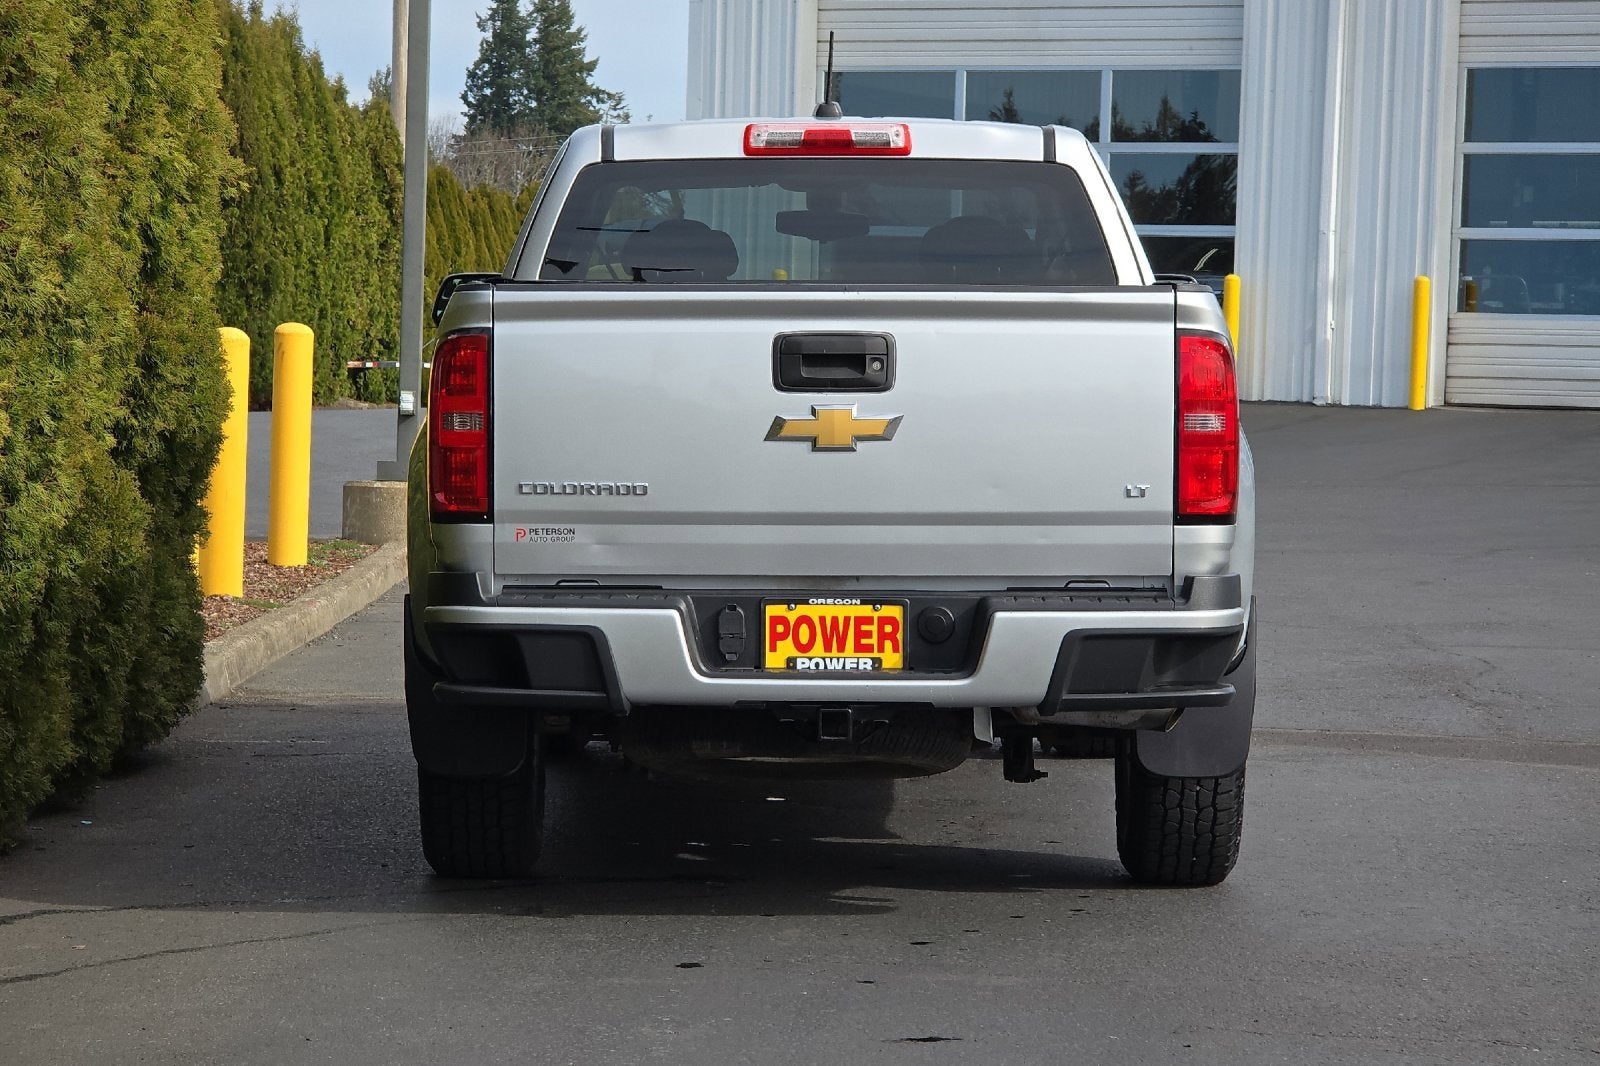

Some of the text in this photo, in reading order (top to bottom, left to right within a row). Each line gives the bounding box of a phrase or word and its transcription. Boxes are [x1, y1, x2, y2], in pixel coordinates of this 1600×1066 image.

[518, 481, 649, 496] COLORADO
[1125, 484, 1151, 498] LT
[529, 527, 576, 536] PETERSON
[769, 615, 901, 654] POWER
[796, 657, 873, 671] POWER
